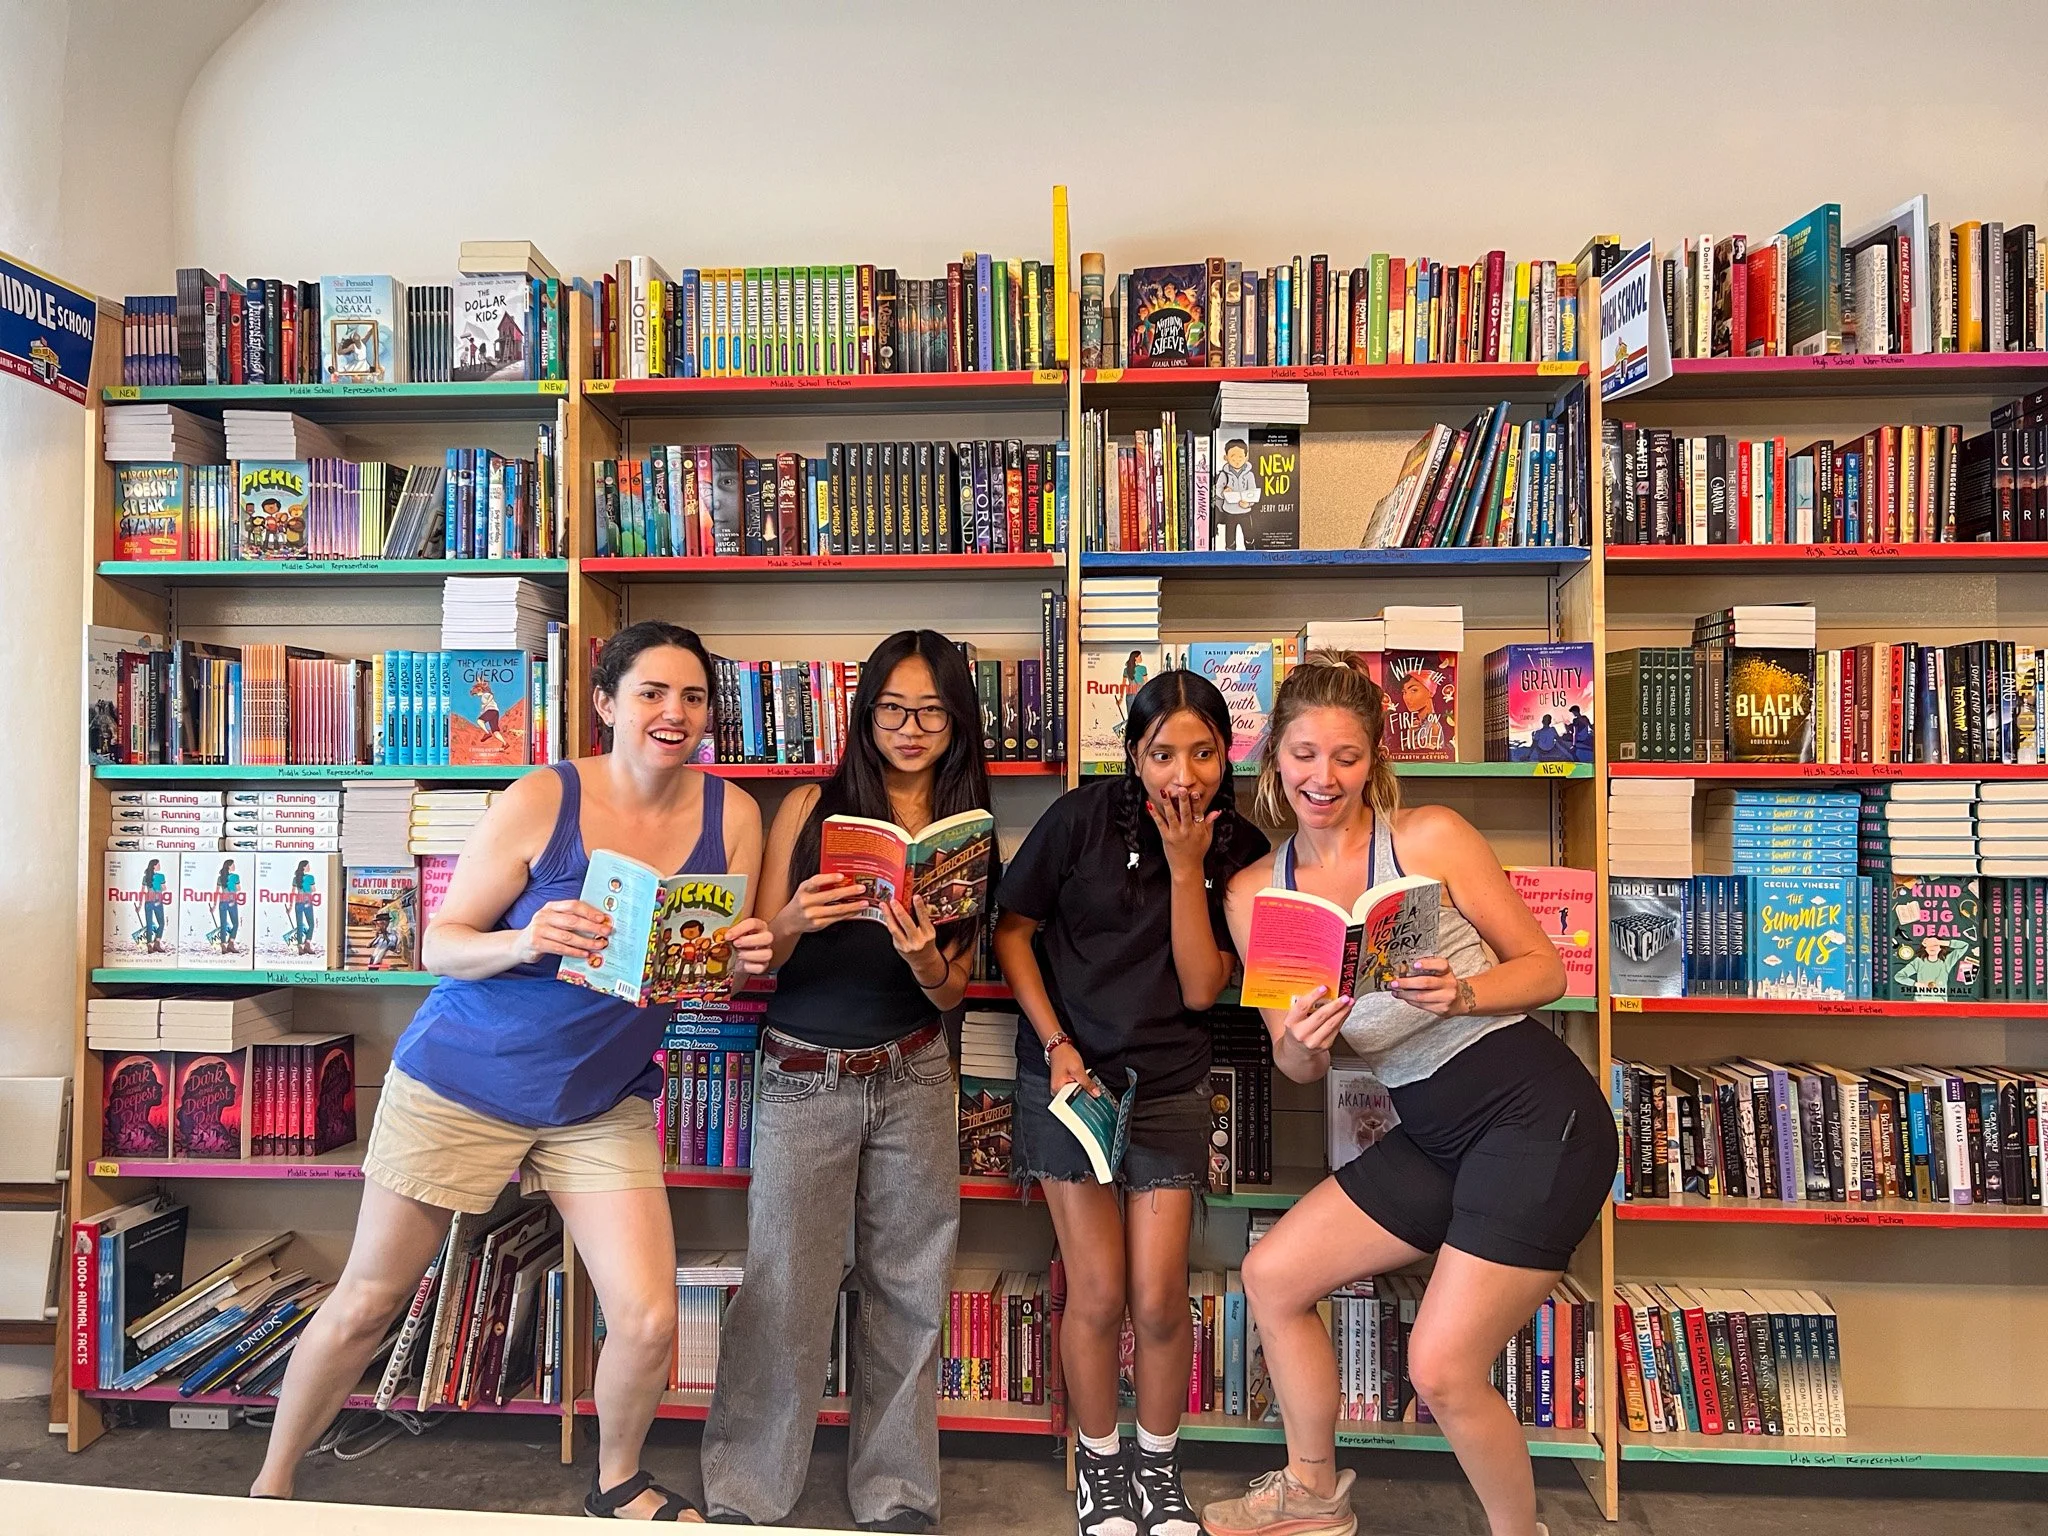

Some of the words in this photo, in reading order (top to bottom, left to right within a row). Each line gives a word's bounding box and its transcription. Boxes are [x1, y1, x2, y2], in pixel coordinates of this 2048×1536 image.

[1903, 255, 1909, 268] WE
[336, 295, 371, 304] NAOMI
[478, 289, 490, 297] THE
[335, 304, 372, 313] OSAKA
[464, 295, 507, 312] DOLLAR
[1601, 296, 1616, 340] HIGH
[1617, 274, 1647, 327] SCHOOL
[57, 305, 93, 341] SCHOOL
[475, 311, 498, 322] KIDS
[633, 286, 646, 353] LORE
[1156, 316, 1184, 333] NOTHING
[1161, 329, 1170, 338] UP
[1170, 327, 1180, 336] MY
[1152, 337, 1185, 356] SLEEVE
[1813, 357, 1828, 368] High
[1040, 373, 1058, 381] NEW
[1272, 369, 1296, 378] Middle
[1304, 369, 1327, 377] School
[314, 386, 334, 394] School
[343, 386, 397, 394] Representation
[544, 383, 562, 391] NEW
[592, 382, 610, 390] NEW
[770, 379, 795, 387] Middle
[798, 379, 820, 387] School
[119, 389, 136, 398] NEW
[1259, 454, 1295, 476] NEW
[120, 470, 152, 481] MARCUS
[153, 468, 179, 479] VEGA
[241, 468, 303, 495] PICKLE
[123, 479, 177, 498] DOESN'T
[123, 499, 166, 516] SPEAK
[961, 477, 973, 544] FOUND
[977, 479, 989, 539] TORN
[1260, 504, 1278, 512] JERRY
[1281, 504, 1294, 512] CRAFT
[119, 516, 175, 537] SPANISH
[1806, 547, 1824, 557] High
[1830, 547, 1858, 556] School
[1869, 547, 1899, 556] Fiction
[331, 562, 379, 570] Representation
[1203, 659, 1262, 679] Counting
[1390, 657, 1425, 681] WITH
[1539, 658, 1553, 668] THE
[464, 668, 514, 683] GÜERO
[1428, 671, 1446, 686] THE
[1521, 667, 1583, 692] GRAVITY
[1927, 653, 1935, 691] Earthseed
[1220, 679, 1258, 693] Down
[1228, 695, 1255, 710] with
[1539, 694, 1549, 706] OF
[1552, 691, 1567, 707] US
[1736, 694, 1805, 717] BLACK
[1844, 679, 1852, 742] EVERNIGHT
[1231, 715, 1254, 730] You
[1390, 711, 1418, 734] FIRE
[1428, 714, 1440, 723] ON
[1751, 716, 1791, 737] OUT
[1400, 728, 1442, 751] HIGH
[326, 769, 374, 777] Representation
[1104, 763, 1124, 772] NEW
[1543, 764, 1563, 774] NEW
[1830, 767, 1858, 775] School
[1873, 767, 1902, 775] Fiction
[159, 795, 198, 805] Running
[276, 795, 315, 804] Running
[157, 840, 195, 849] Running
[275, 840, 314, 849] Running
[424, 858, 447, 868] The
[352, 879, 387, 888] CLAYTON
[392, 878, 412, 888] BYRD
[1515, 875, 1540, 887] The
[1764, 881, 1798, 889] CECILIA
[108, 888, 172, 904] Running
[183, 889, 246, 905] Running
[259, 889, 321, 905] Running
[1610, 884, 1655, 896] MARIE
[1658, 884, 1675, 896] LU
[1911, 885, 1961, 897] KIND
[664, 882, 734, 918] PICKLE
[1787, 894, 1803, 905] THE
[1924, 900, 1938, 908] OF
[1372, 910, 1402, 935] LIKE
[1408, 907, 1418, 917] A
[1920, 910, 1954, 922] BIG
[1375, 920, 1413, 942] LOVE
[1912, 924, 1961, 937] DEAL
[1375, 934, 1422, 953] STORY
[1777, 938, 1792, 948] OF
[1796, 936, 1838, 965] US
[267, 973, 289, 983] Middle
[295, 973, 318, 982] School
[325, 974, 379, 983] Representation
[1901, 986, 1946, 994] SHANNON
[1620, 1001, 1639, 1009] NEW
[1818, 1005, 1832, 1013] High
[1834, 1005, 1854, 1013] School
[1860, 1005, 1883, 1013] Fiction
[117, 1070, 150, 1091] Dark
[114, 1087, 157, 1112] Deepest
[1339, 1094, 1370, 1108] AKATA
[78, 1256, 88, 1288] 1000+
[411, 1276, 431, 1317] WORLD
[78, 1291, 88, 1332] ANIMAL
[236, 1314, 283, 1355] SCIENCE
[1692, 1322, 1706, 1346] THE
[78, 1336, 88, 1365] FACTS
[1639, 1333, 1656, 1380] STAMPED
[1695, 1349, 1710, 1376] HATE
[1703, 1390, 1716, 1415] GIVE
[1339, 1436, 1395, 1444] Representation
[1847, 1455, 1922, 1464] Representation
